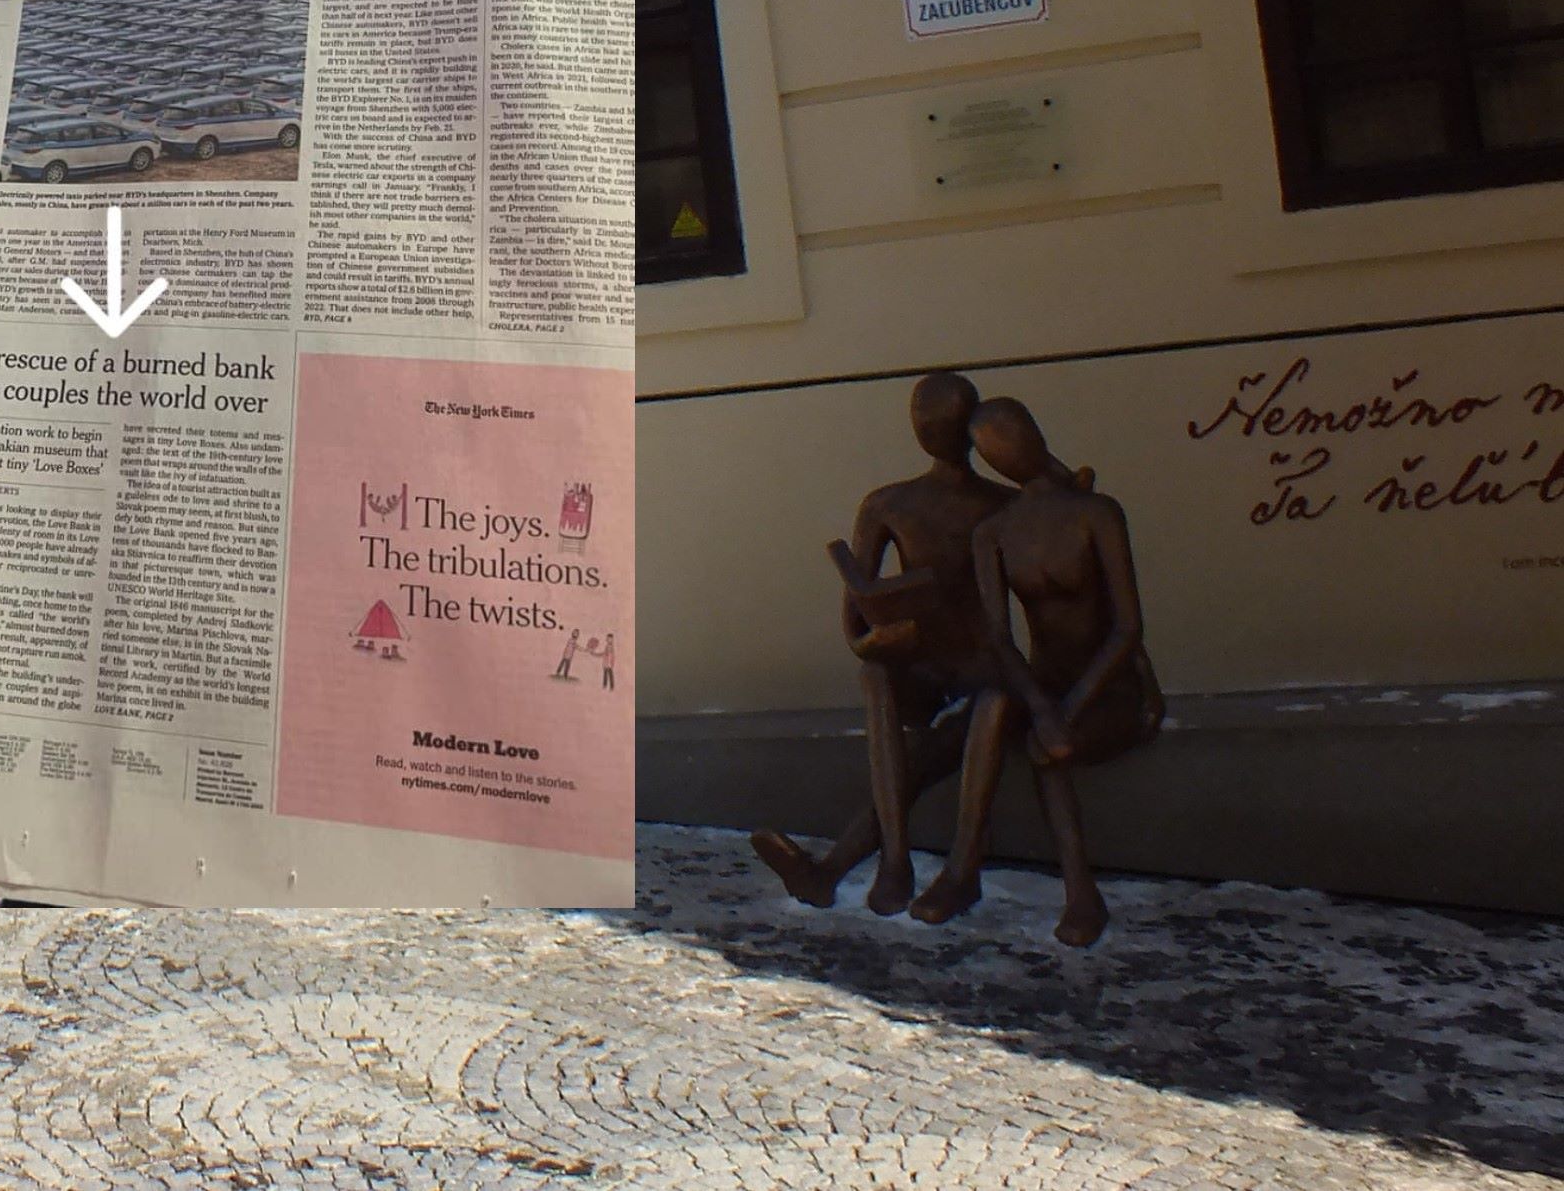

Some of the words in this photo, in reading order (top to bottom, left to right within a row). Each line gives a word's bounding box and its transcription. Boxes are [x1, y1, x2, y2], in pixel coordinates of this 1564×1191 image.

[74, 349, 99, 373] of
[102, 358, 116, 373] a
[123, 350, 206, 377] burned
[215, 353, 275, 380] bank
[4, 380, 89, 407] couples
[96, 381, 132, 406] the
[140, 385, 206, 411] world
[214, 396, 269, 414] over
[424, 401, 447, 415] The
[447, 403, 471, 417] New
[472, 405, 500, 419] York
[500, 406, 536, 420] Times
[26, 424, 54, 440] work
[57, 426, 69, 440] to
[72, 427, 102, 444] begin
[6, 456, 29, 474] tiny
[33, 443, 83, 459] museum
[86, 444, 109, 459] that
[415, 497, 476, 531] The
[480, 505, 550, 543] joys.
[359, 535, 420, 571] The
[428, 545, 609, 589] tribulations.
[399, 584, 461, 621] The
[469, 596, 565, 631] twists.
[412, 730, 490, 755] Modern
[494, 740, 540, 760] Love
[375, 755, 406, 771] Read,
[409, 760, 442, 773] watch
[445, 763, 466, 777] and
[468, 766, 499, 781] listen
[501, 770, 512, 782] to
[515, 771, 534, 785] the
[536, 774, 577, 791] stories.
[401, 775, 552, 805] nytimes.com/modernlove
